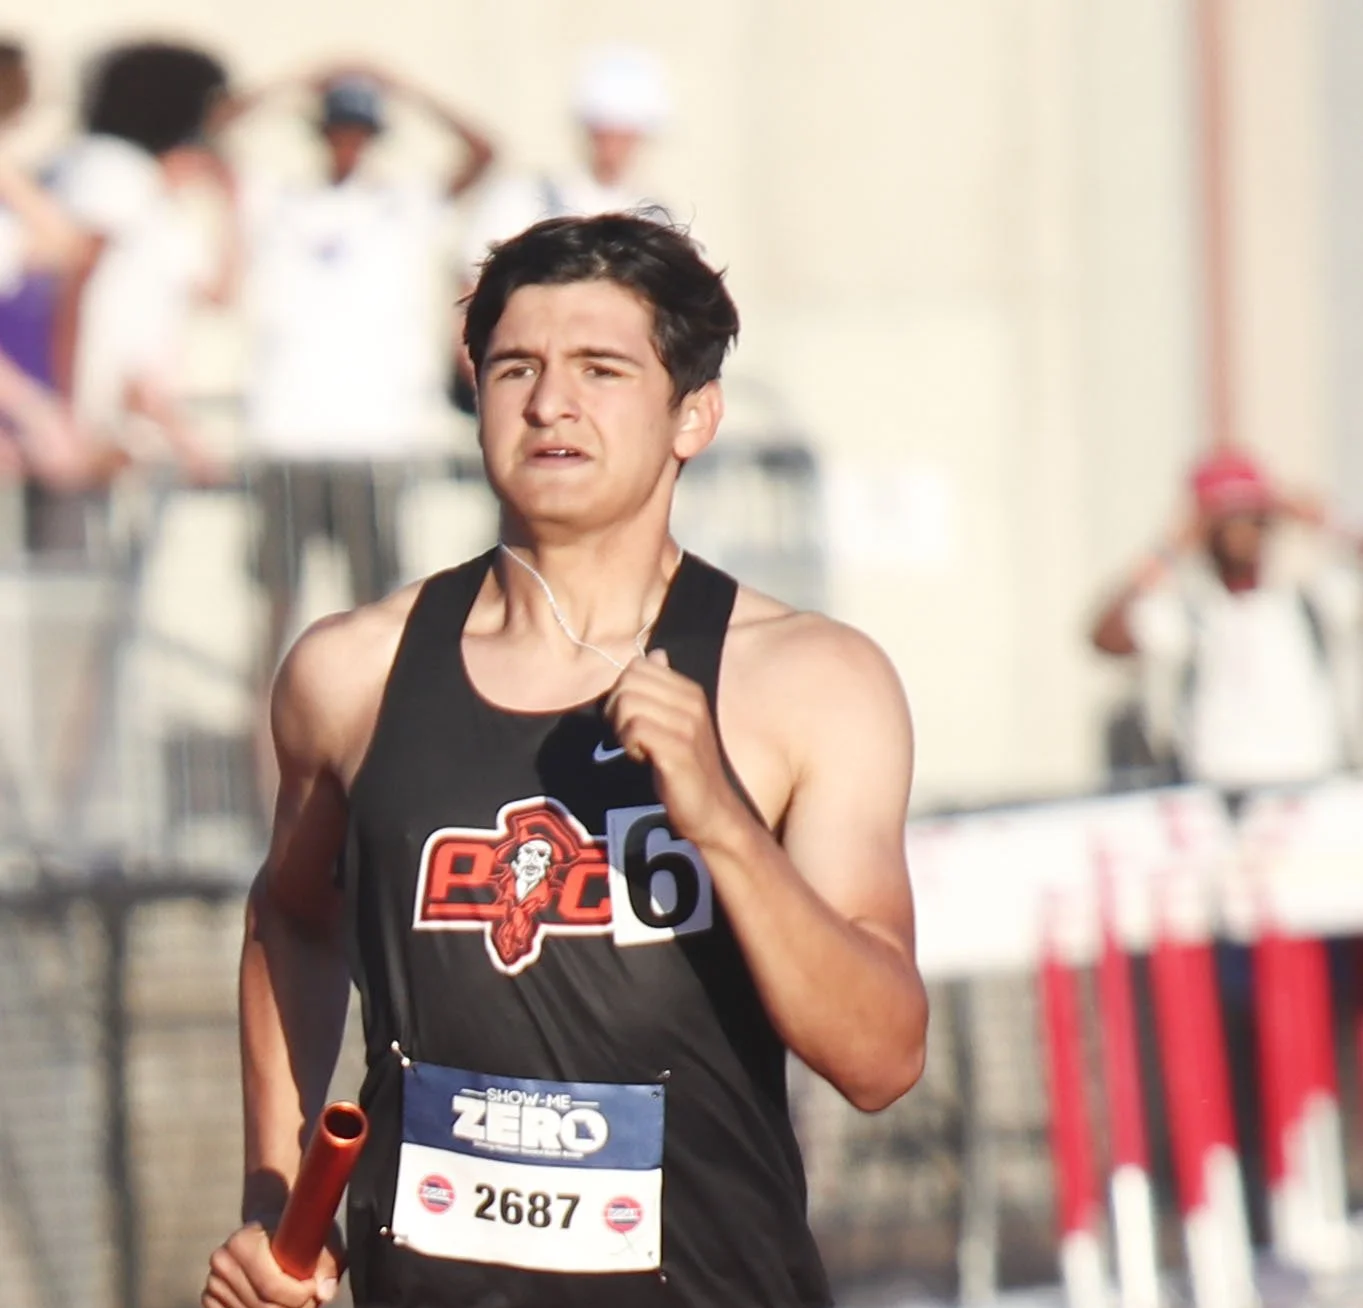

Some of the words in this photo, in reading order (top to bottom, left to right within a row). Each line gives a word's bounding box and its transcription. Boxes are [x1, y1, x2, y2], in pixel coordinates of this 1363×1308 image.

[623, 811, 702, 929] 6
[452, 1094, 609, 1153] ZERO
[486, 1087, 572, 1109] SHOW-ME
[474, 1183, 581, 1229] 2687
